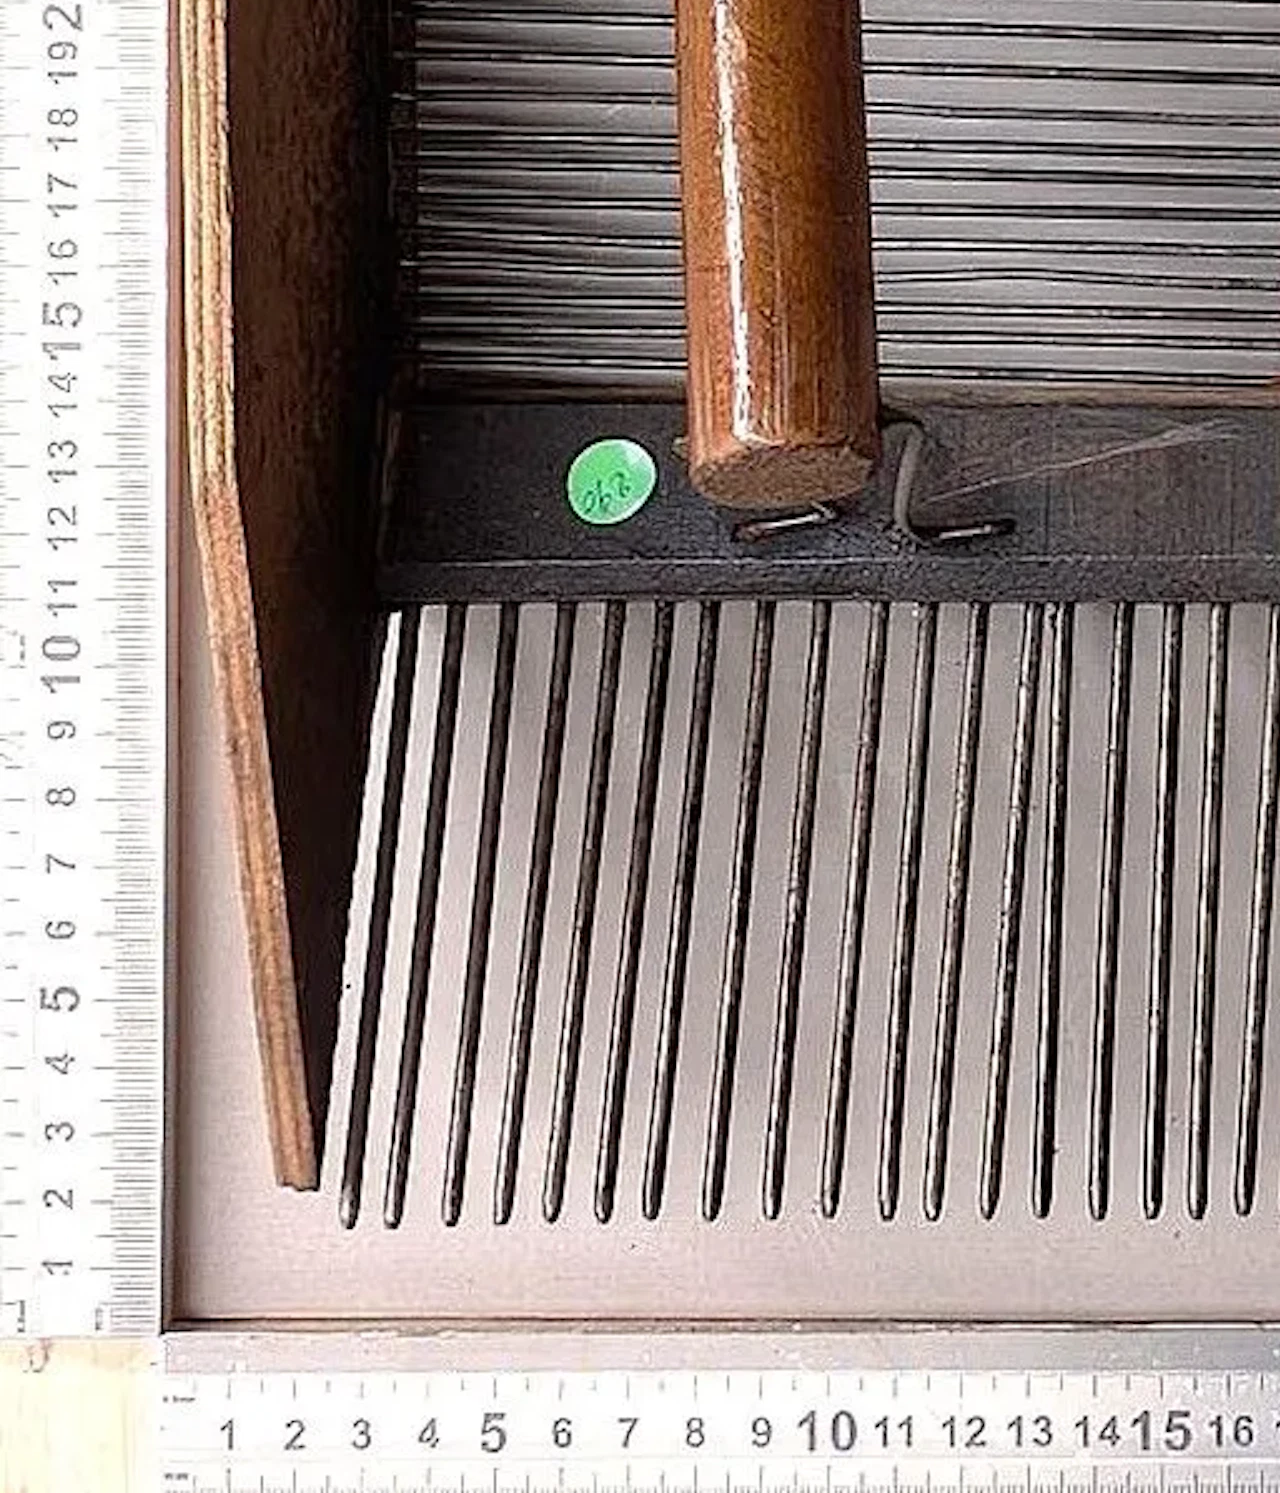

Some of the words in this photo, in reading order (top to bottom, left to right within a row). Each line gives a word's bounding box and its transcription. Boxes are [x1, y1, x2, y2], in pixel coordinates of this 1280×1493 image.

[47, 41, 78, 85] 19
[47, 108, 78, 152] 18
[47, 173, 77, 218] 17
[47, 239, 78, 285] 16
[42, 302, 82, 361] 15
[47, 375, 78, 418] 14
[47, 440, 78, 484] 13
[46, 506, 78, 551] 12
[47, 580, 77, 617] 11
[40, 635, 81, 694] 10
[47, 721, 76, 740] 9
[46, 786, 76, 807] 8
[46, 854, 76, 874] 7
[45, 921, 76, 940] 6
[39, 986, 80, 1012] 5
[45, 1053, 75, 1075] 4
[44, 1122, 75, 1142] 3
[42, 1189, 73, 1210] 2
[219, 1418, 234, 1451] 1
[283, 1418, 307, 1451] 2
[350, 1417, 372, 1451] 3
[417, 1417, 441, 1449] 4
[480, 1411, 508, 1454] 5
[551, 1416, 573, 1449] 6
[617, 1417, 640, 1449] 7
[685, 1416, 706, 1449] 8
[751, 1416, 773, 1449] 9
[796, 1409, 858, 1453] 10
[874, 1414, 913, 1449] 11
[941, 1414, 988, 1449] 12
[1006, 1414, 1054, 1448] 13
[1074, 1414, 1122, 1449] 14
[1130, 1409, 1193, 1452] 15
[1208, 1414, 1254, 1449] 16
